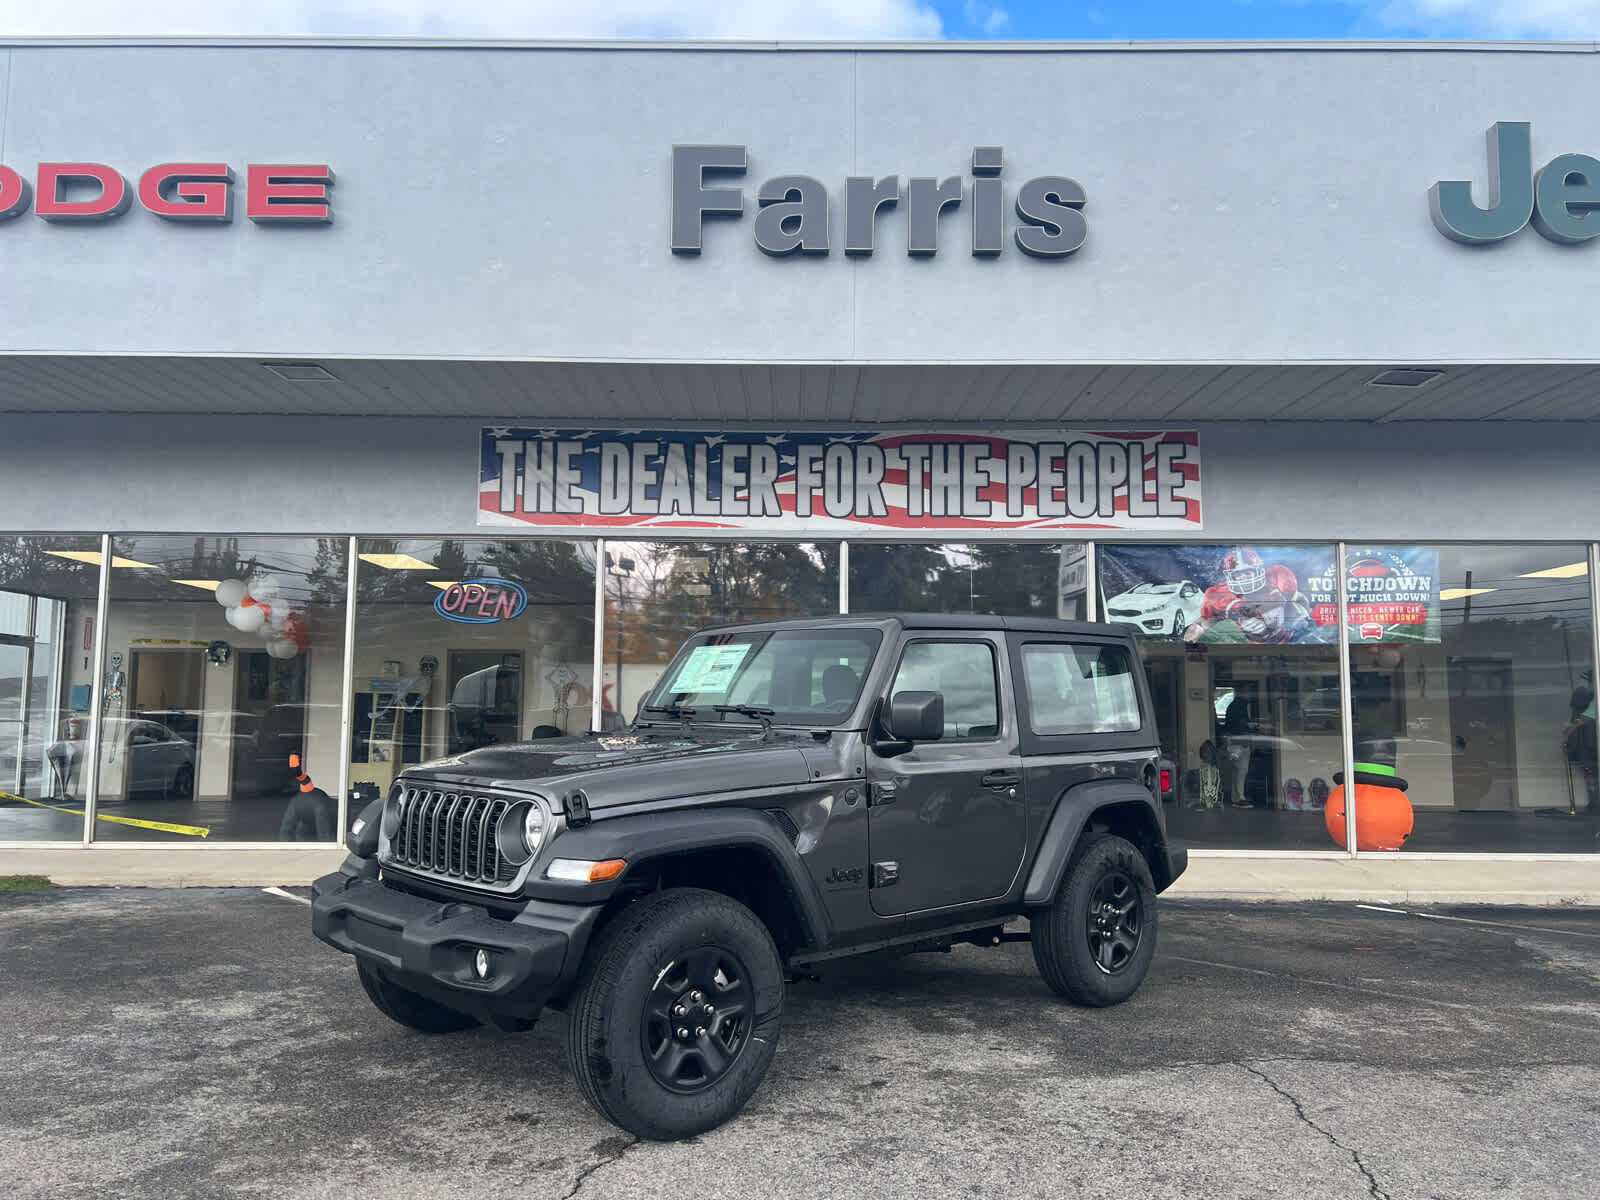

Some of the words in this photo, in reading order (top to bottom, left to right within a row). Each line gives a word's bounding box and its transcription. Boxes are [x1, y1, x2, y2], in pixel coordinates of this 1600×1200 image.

[0, 162, 335, 223] DGE
[671, 144, 1088, 257] Farris
[1428, 121, 1600, 246] Je
[496, 440, 585, 514] THE
[598, 441, 782, 518] DEALER
[795, 442, 889, 518] FOR
[900, 441, 992, 518] THE
[1006, 441, 1188, 519] PEOPLE
[442, 583, 518, 619] OPEN
[1308, 576, 1432, 592] TOCHDOWN
[1311, 593, 1332, 603] FOR
[1359, 593, 1392, 602] MUCH
[1396, 592, 1431, 602] DOWN!
